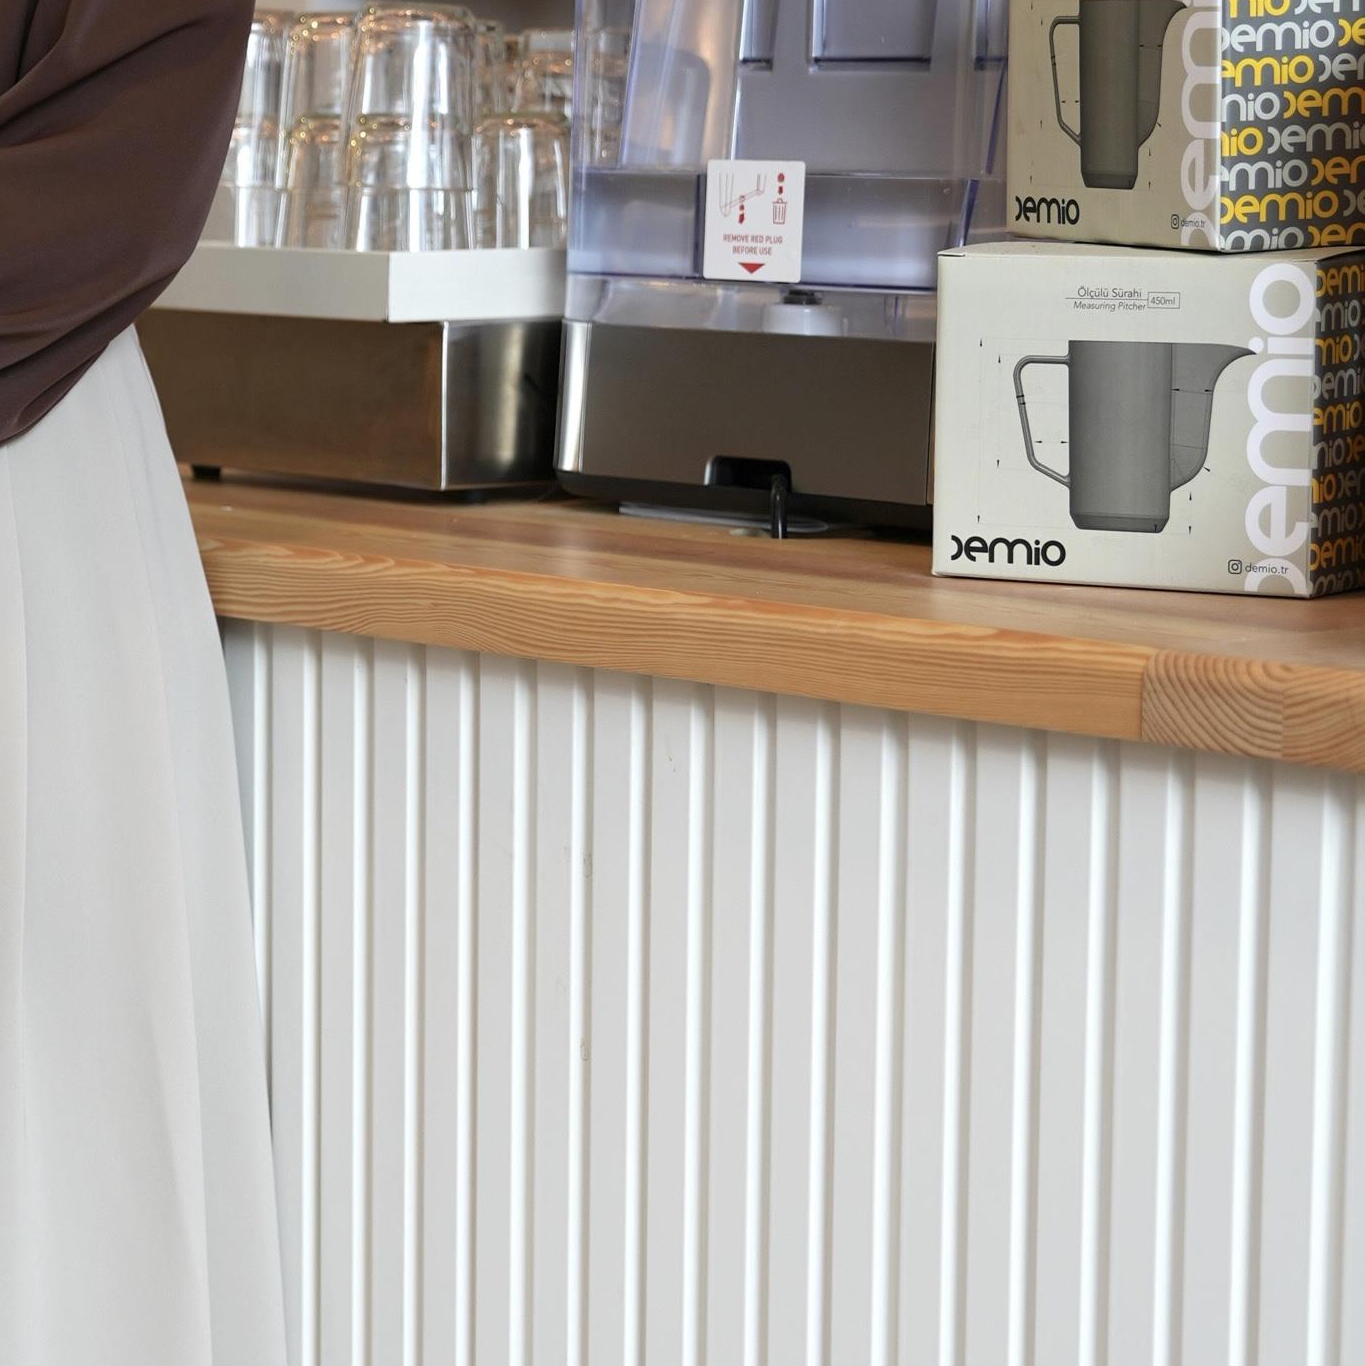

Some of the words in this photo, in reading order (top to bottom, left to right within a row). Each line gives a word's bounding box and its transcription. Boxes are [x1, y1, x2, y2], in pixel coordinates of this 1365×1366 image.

[723, 234, 749, 242] REMOVE
[750, 235, 764, 243] RED
[765, 235, 783, 244] PLUG
[732, 245, 758, 255] BEFORE
[759, 246, 772, 256] USE
[1077, 285, 1109, 299] Ölçülü
[1111, 287, 1142, 299] Sürahi
[1074, 301, 1116, 312] Measuring
[1118, 302, 1147, 311] Pitcher
[1150, 296, 1176, 306] 450ml
[1244, 563, 1290, 575] demio.tr
